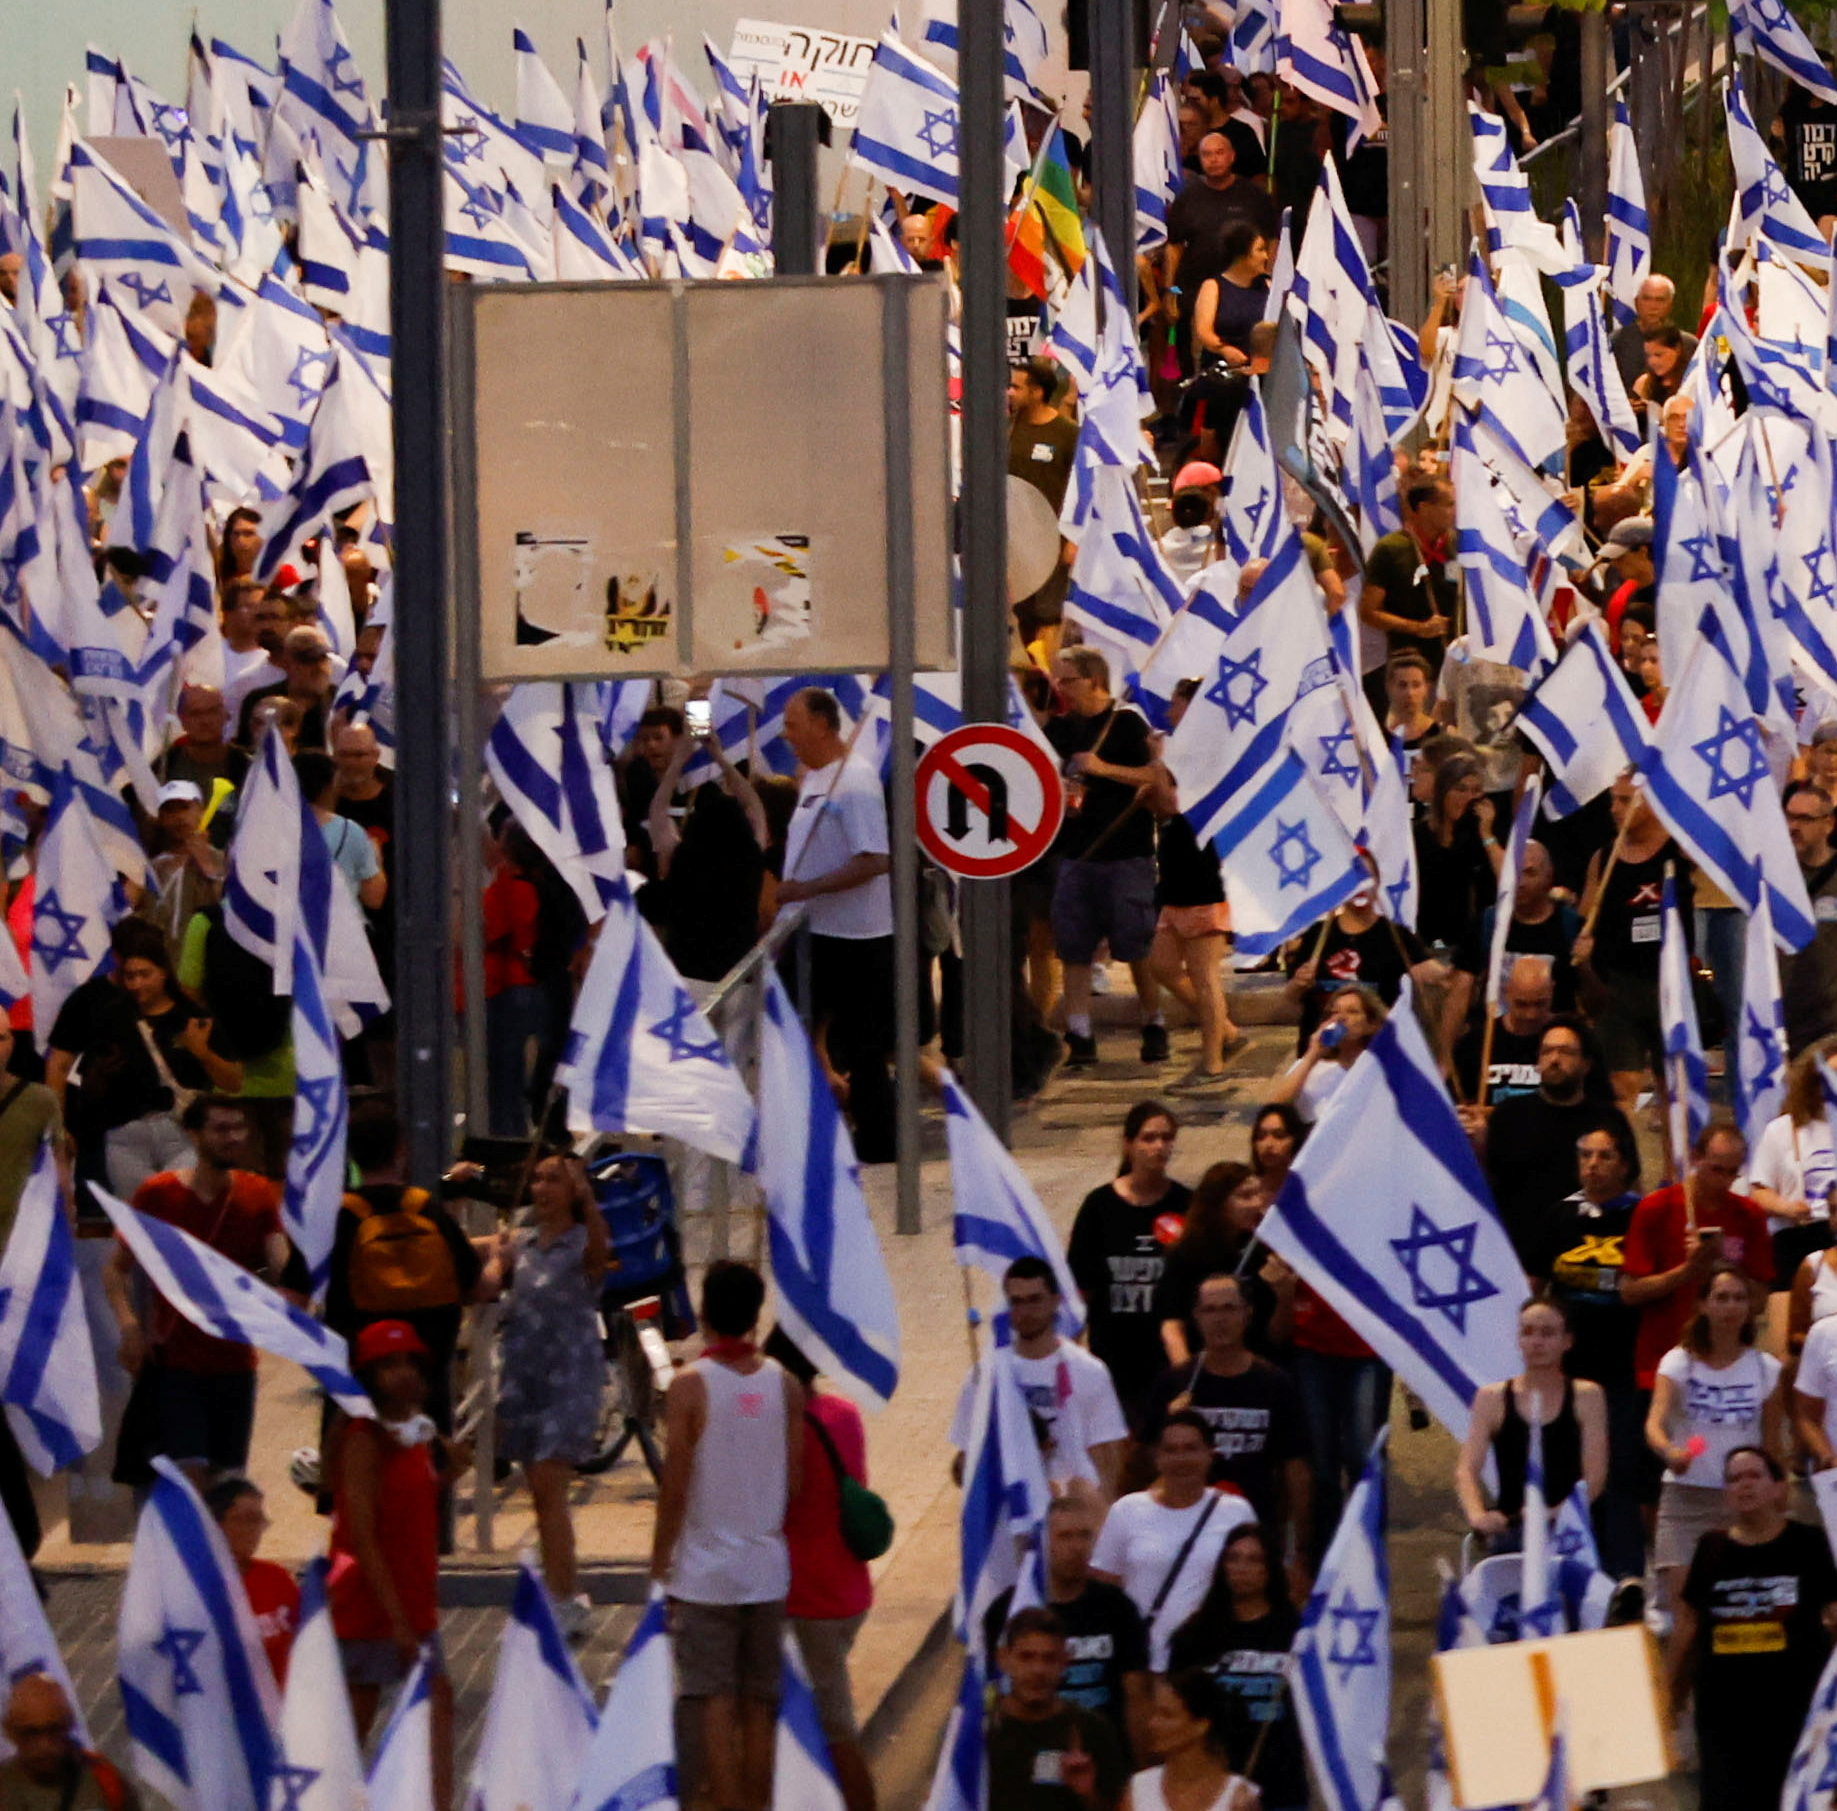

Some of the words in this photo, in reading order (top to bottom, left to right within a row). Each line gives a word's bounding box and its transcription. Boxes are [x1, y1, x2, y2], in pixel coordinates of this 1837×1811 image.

[784, 30, 875, 71] חוקה
[779, 70, 809, 90] או
[1801, 122, 1837, 143] דמו
[1802, 142, 1836, 166] קרט
[1803, 159, 1822, 182] יה
[1006, 316, 1041, 338] דמו
